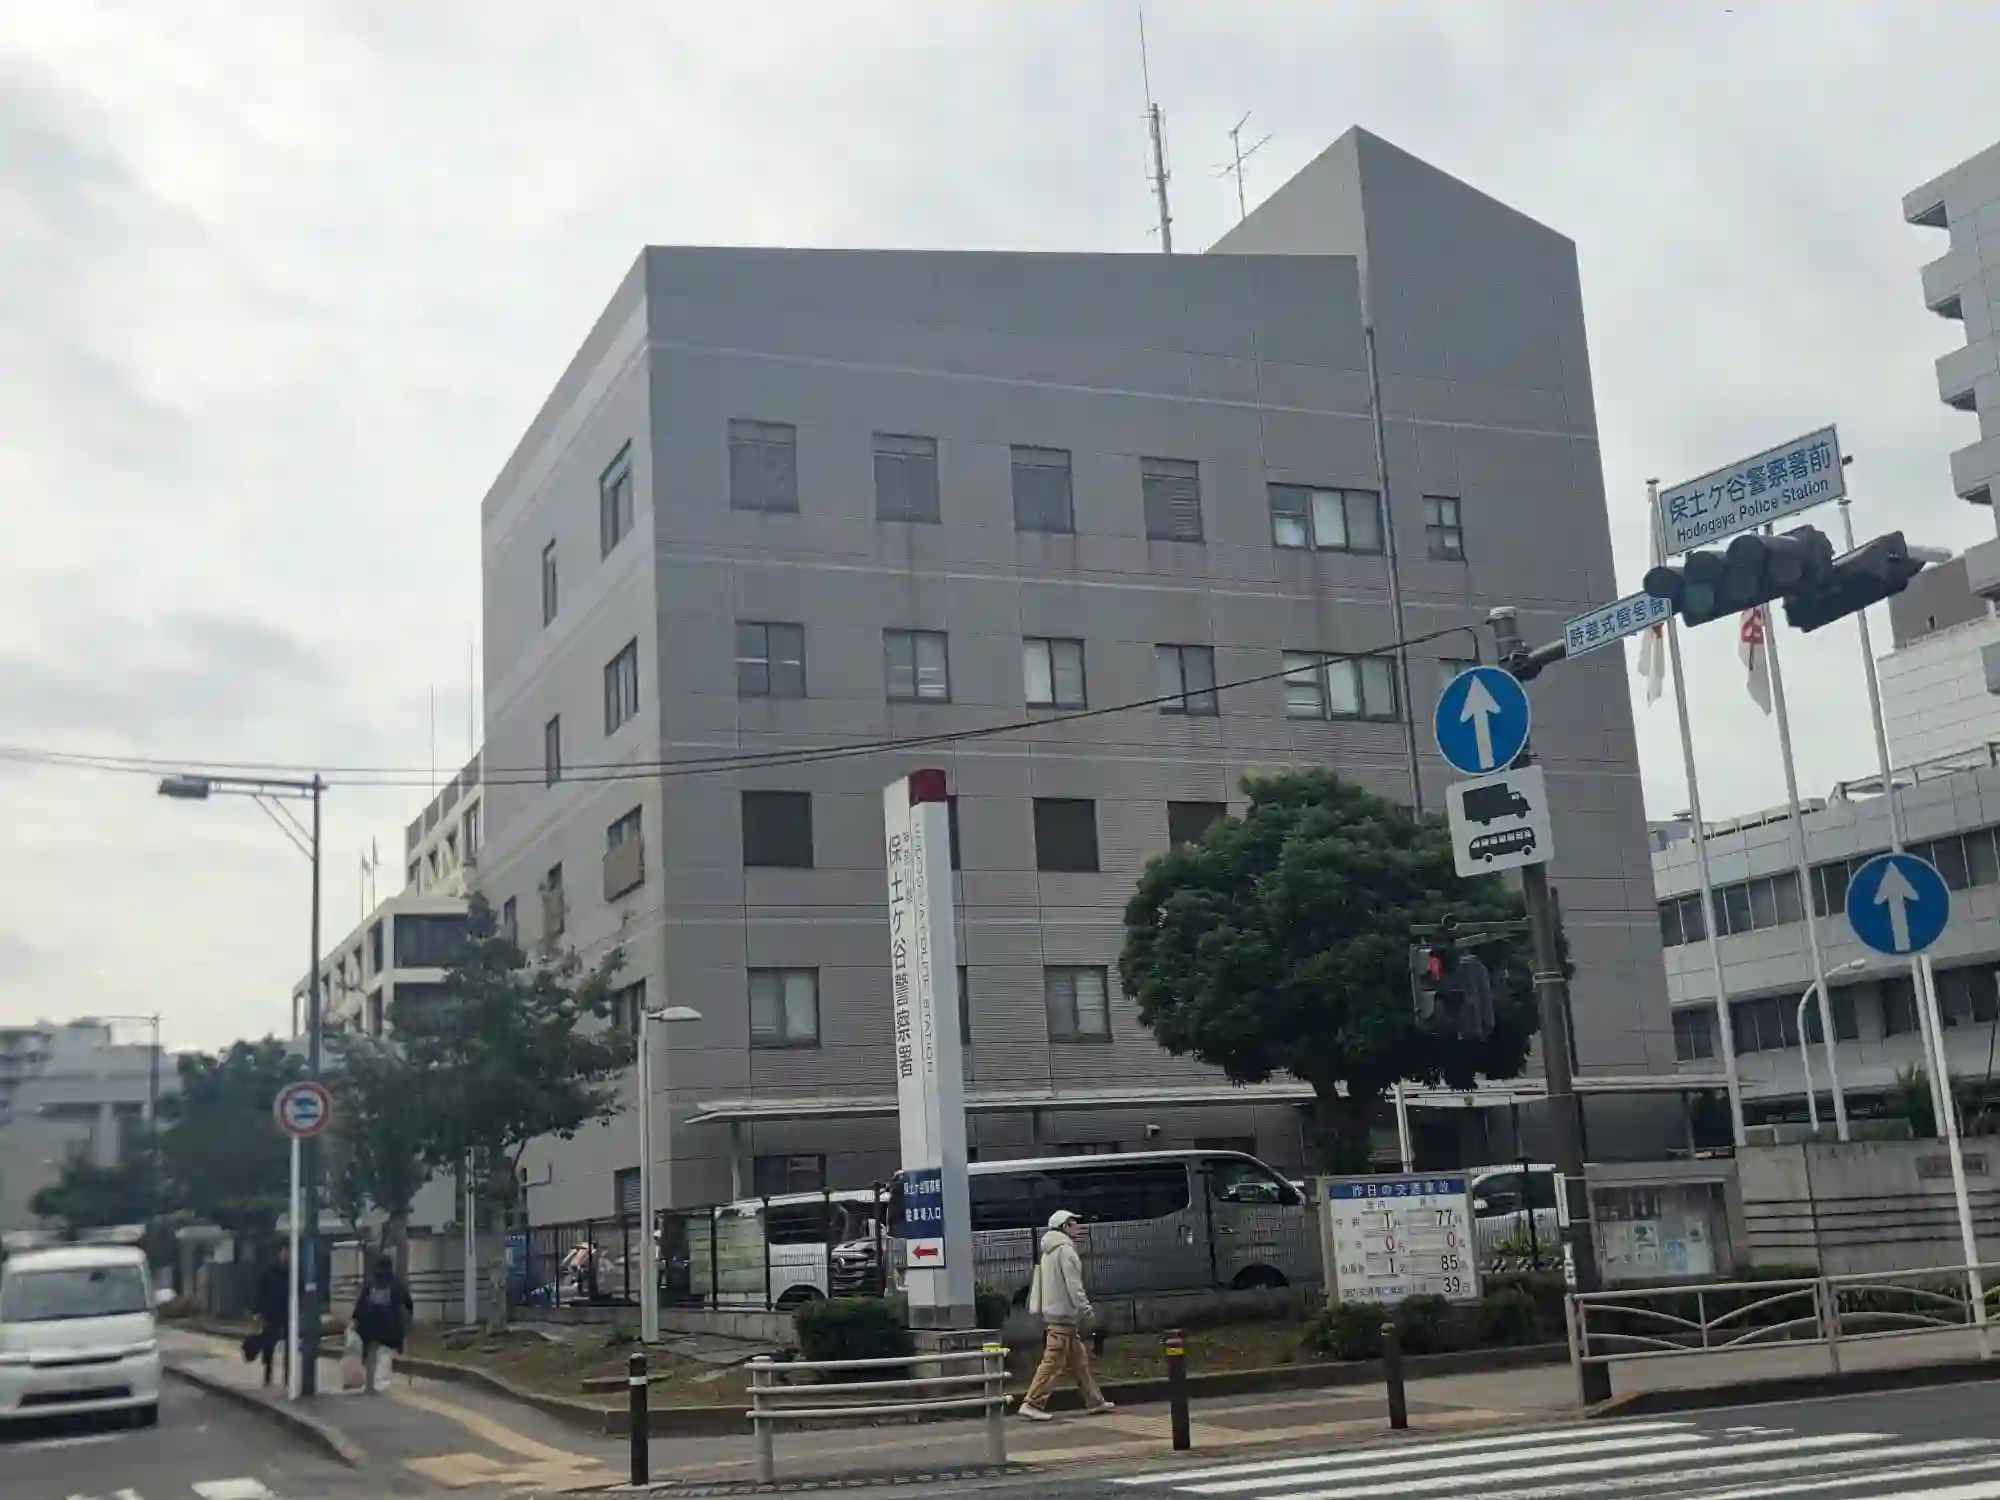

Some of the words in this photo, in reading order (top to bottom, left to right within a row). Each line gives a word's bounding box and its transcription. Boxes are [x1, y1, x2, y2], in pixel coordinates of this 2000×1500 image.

[1676, 510, 1737, 543] Hodogaya
[1739, 496, 1778, 522] Police
[1783, 477, 1830, 506] Station
[922, 999, 934, 1073] STATION
[1440, 1254, 1459, 1271] 85
